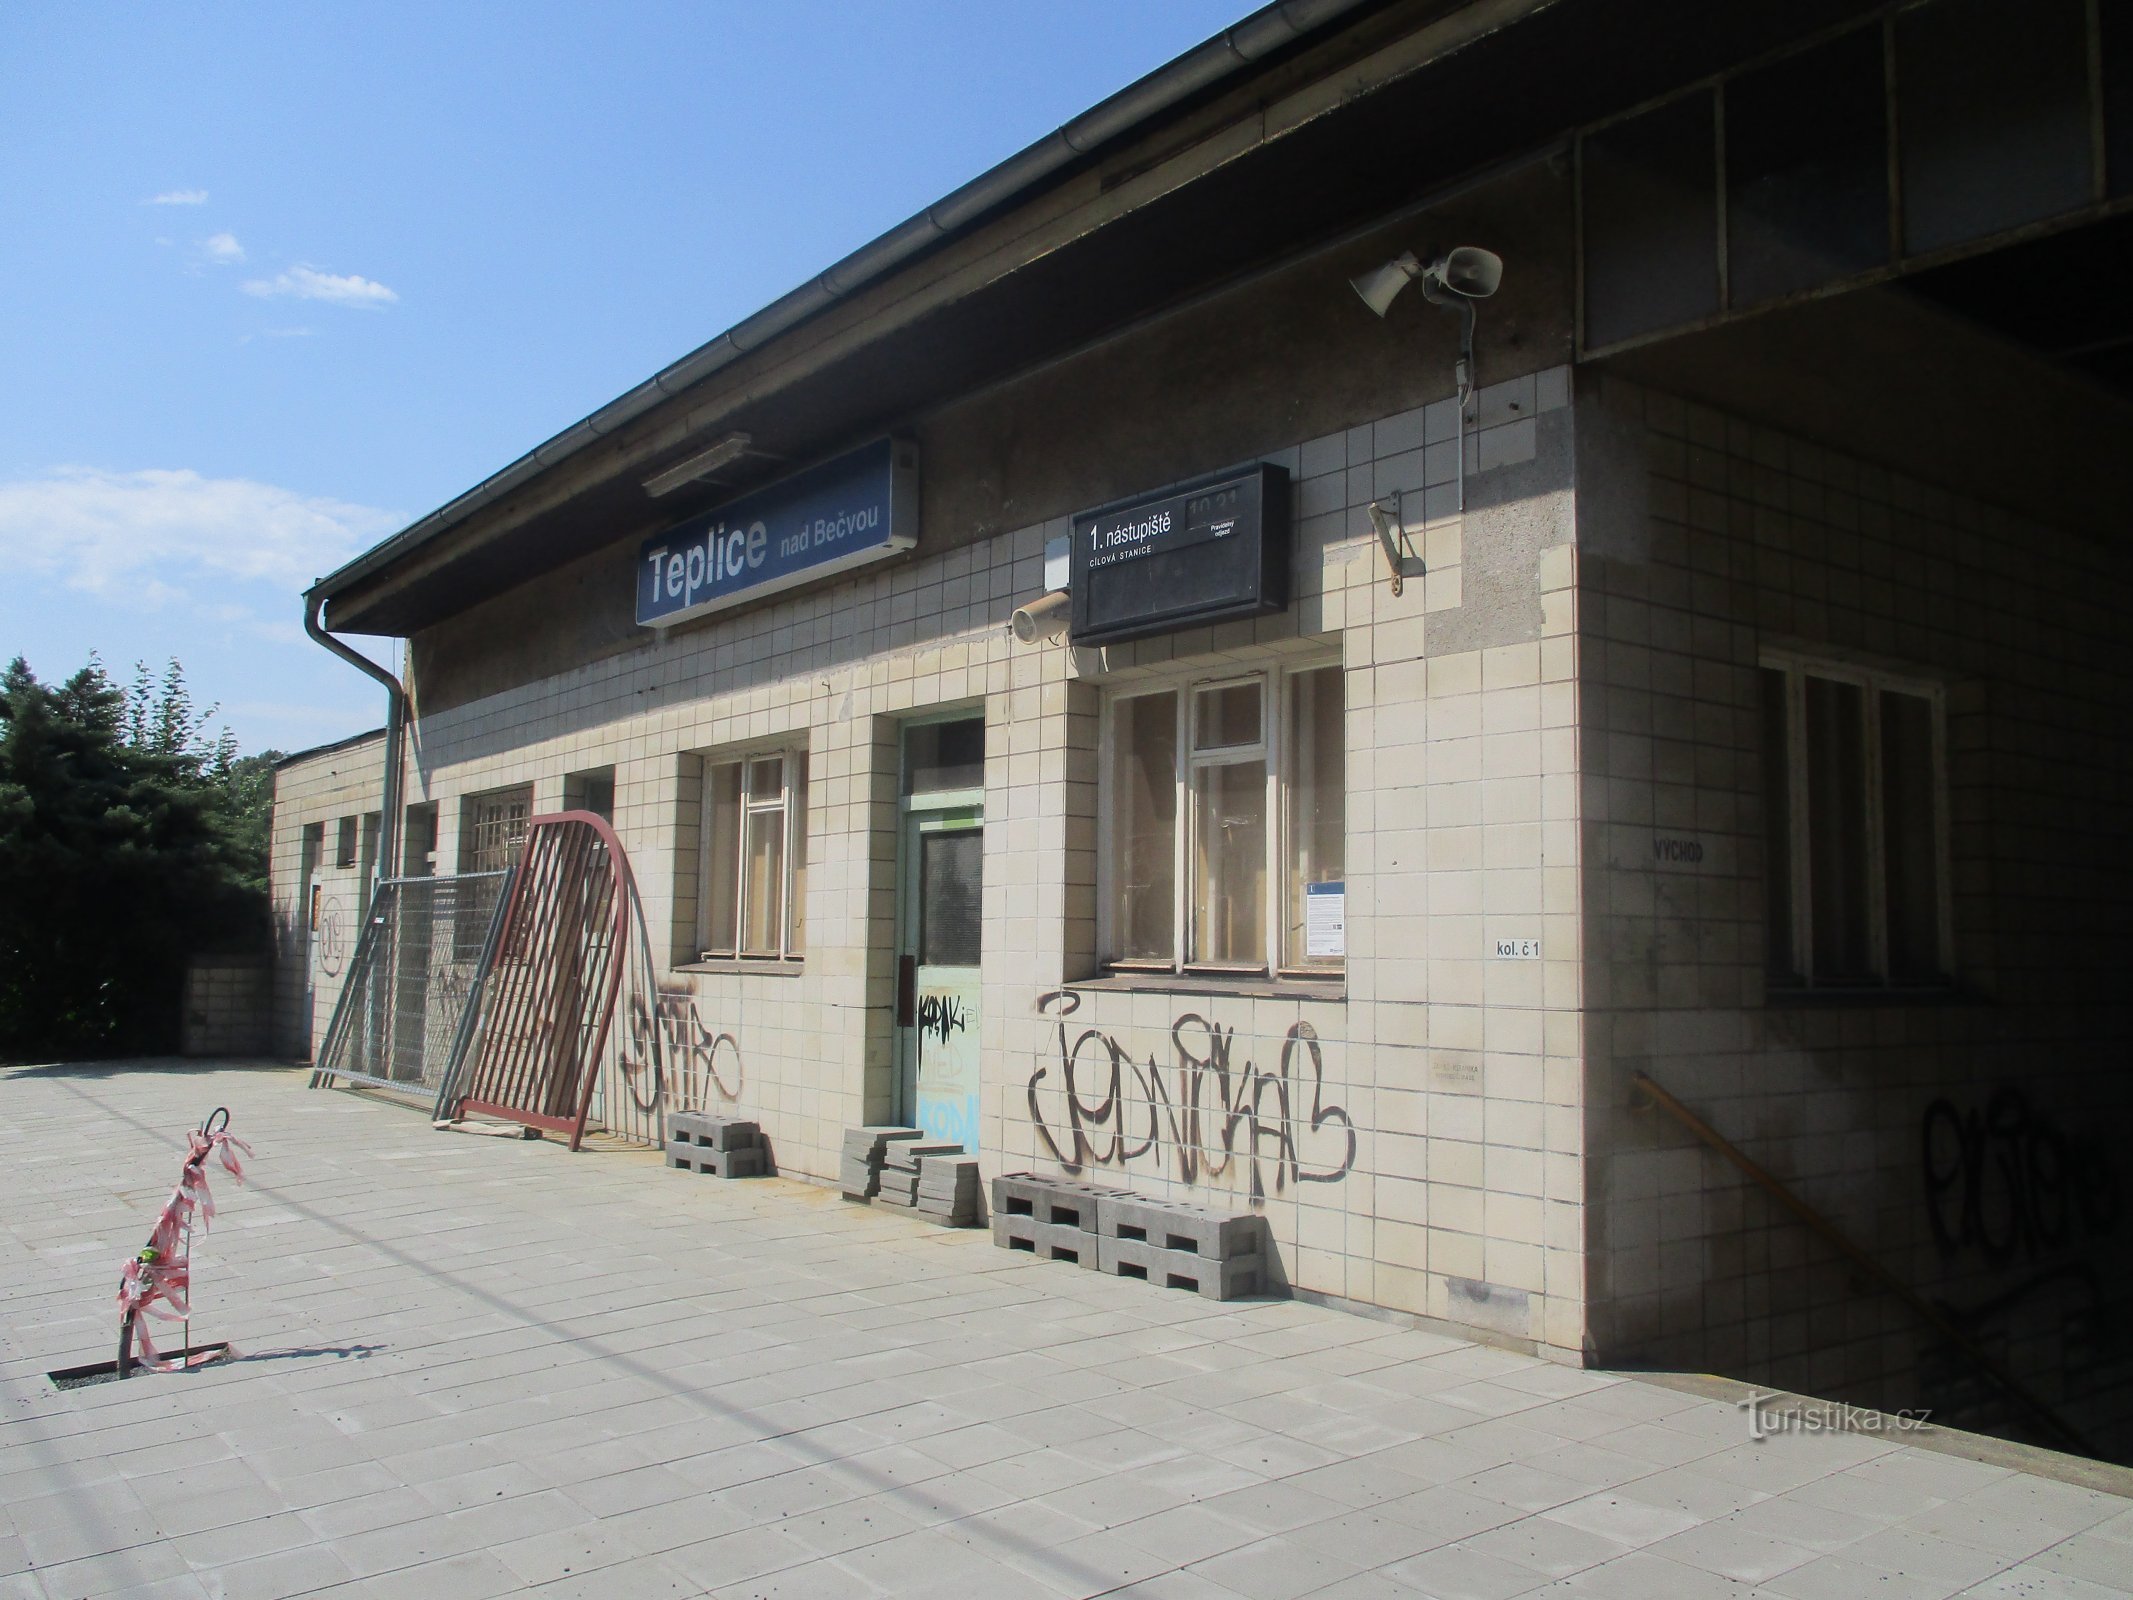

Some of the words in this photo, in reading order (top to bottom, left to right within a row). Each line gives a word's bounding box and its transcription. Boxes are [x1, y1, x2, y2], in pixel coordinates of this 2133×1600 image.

[1089, 523, 1104, 551] 1.
[1106, 510, 1171, 548] nástupiště
[649, 520, 767, 607] Teplice
[780, 524, 809, 558] nad
[814, 504, 879, 544] Bečvou
[1119, 544, 1152, 560] STANICE
[1497, 940, 1518, 956] kol.
[1521, 940, 1530, 956] č
[1533, 941, 1539, 956] 1
